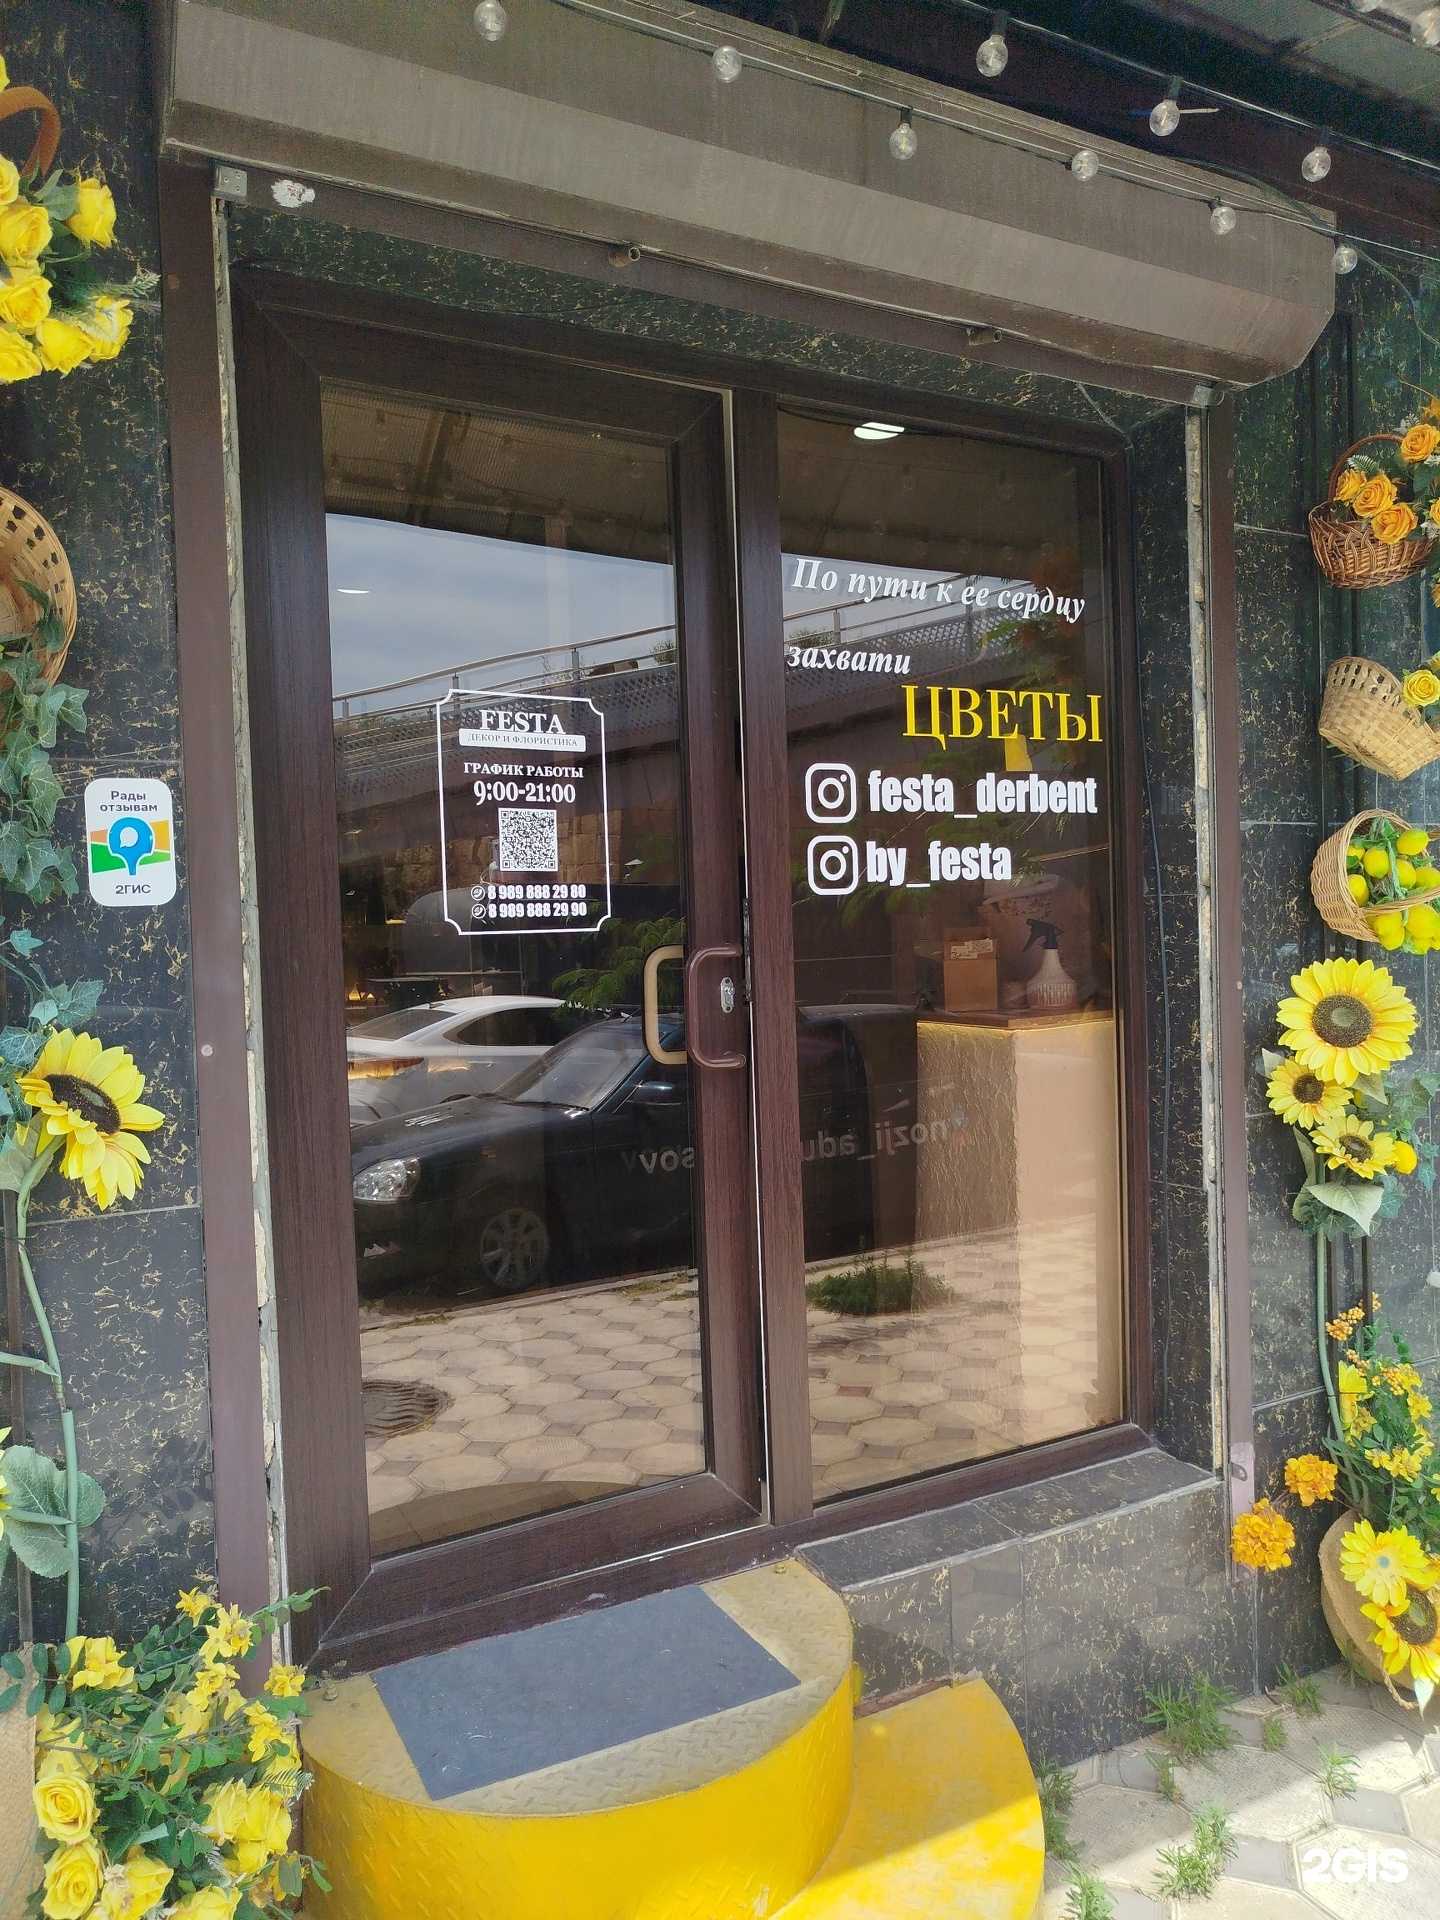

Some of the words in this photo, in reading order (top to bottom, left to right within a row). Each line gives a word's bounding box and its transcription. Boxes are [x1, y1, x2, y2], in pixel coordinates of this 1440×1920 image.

[792, 558, 838, 591] По
[848, 574, 926, 603] пути
[936, 582, 953, 603] к
[961, 586, 988, 607] ее
[997, 587, 1085, 623] сердцу
[787, 645, 911, 674] захвати
[479, 709, 566, 734] FESTA
[901, 684, 1103, 750] ЦВЕТЫ
[512, 735, 578, 747] ФЛОРИСТИКА
[464, 762, 524, 776] ГРАФИК
[526, 765, 584, 778] РАБОТЫ
[111, 790, 146, 801] Рады
[473, 780, 576, 805] 9:00-21:00
[868, 769, 1098, 818] festa_derbent
[100, 803, 158, 812] отзывам
[866, 841, 1012, 888] by_festa
[115, 884, 152, 895] 2ГИС
[488, 885, 496, 899] 8
[499, 884, 524, 899] 989
[526, 884, 550, 899] 888
[552, 884, 568, 899] 29
[570, 884, 586, 899] 80
[488, 903, 497, 918] 8
[500, 902, 525, 918] 989
[526, 902, 551, 917] 888
[552, 902, 569, 917] 29
[570, 901, 587, 916] 90
